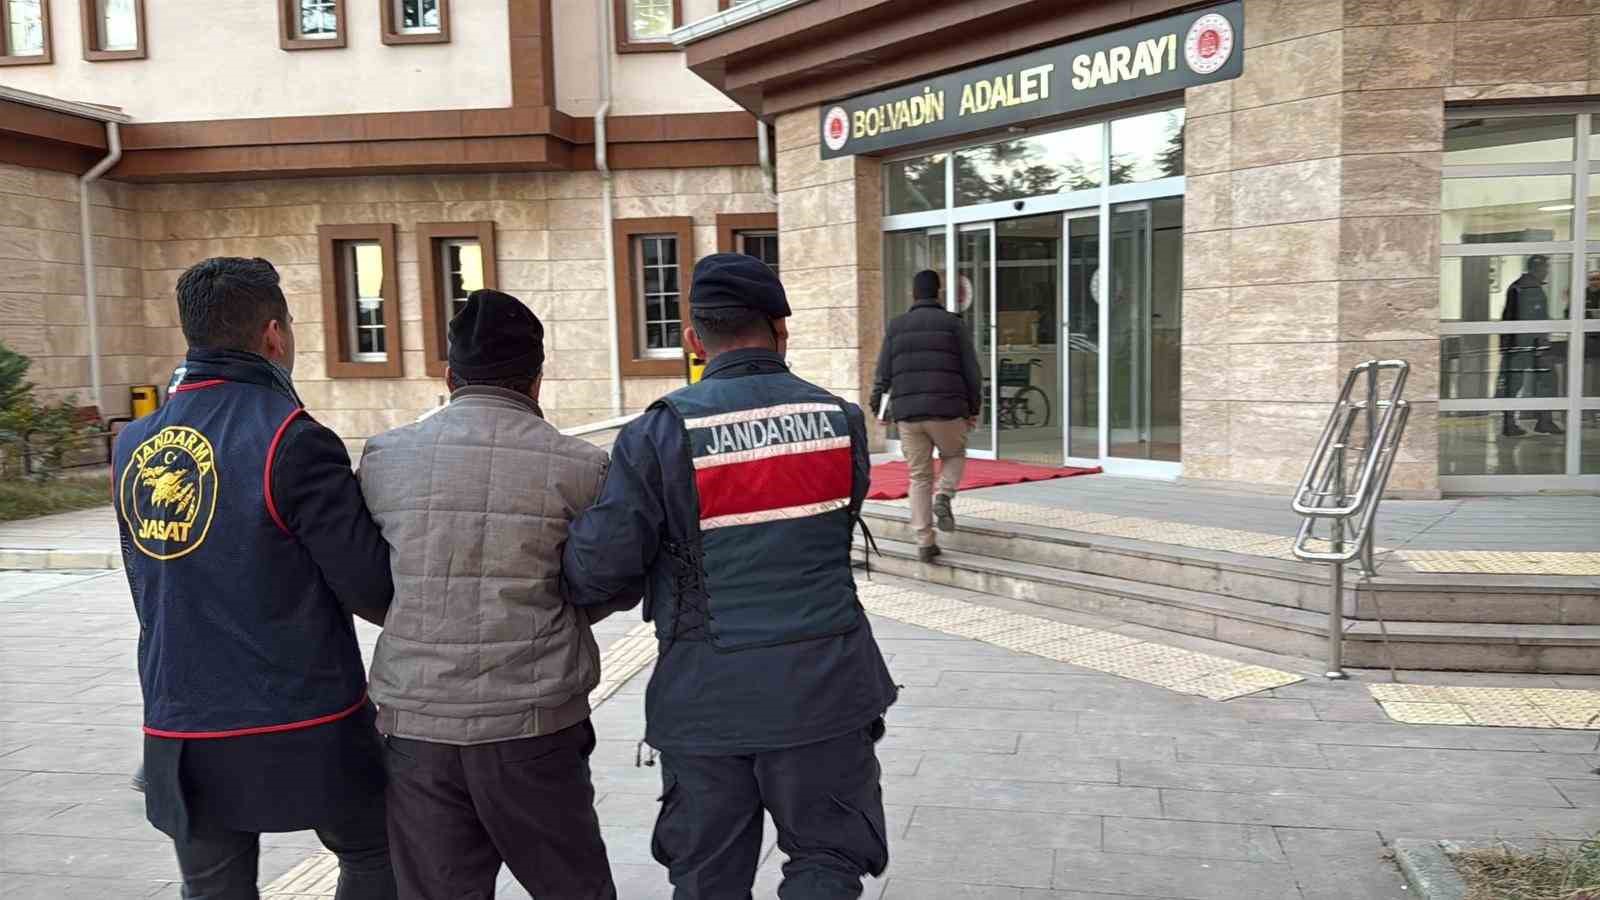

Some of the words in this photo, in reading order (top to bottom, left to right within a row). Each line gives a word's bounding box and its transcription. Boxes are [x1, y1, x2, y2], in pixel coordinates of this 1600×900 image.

[853, 86, 944, 138] BOLVADİN
[959, 64, 1054, 116] ADALET
[1071, 34, 1177, 90] SARAYI
[135, 430, 212, 476] JANDARMA
[706, 412, 836, 454] JANDARMA
[138, 519, 193, 542] JASAT
